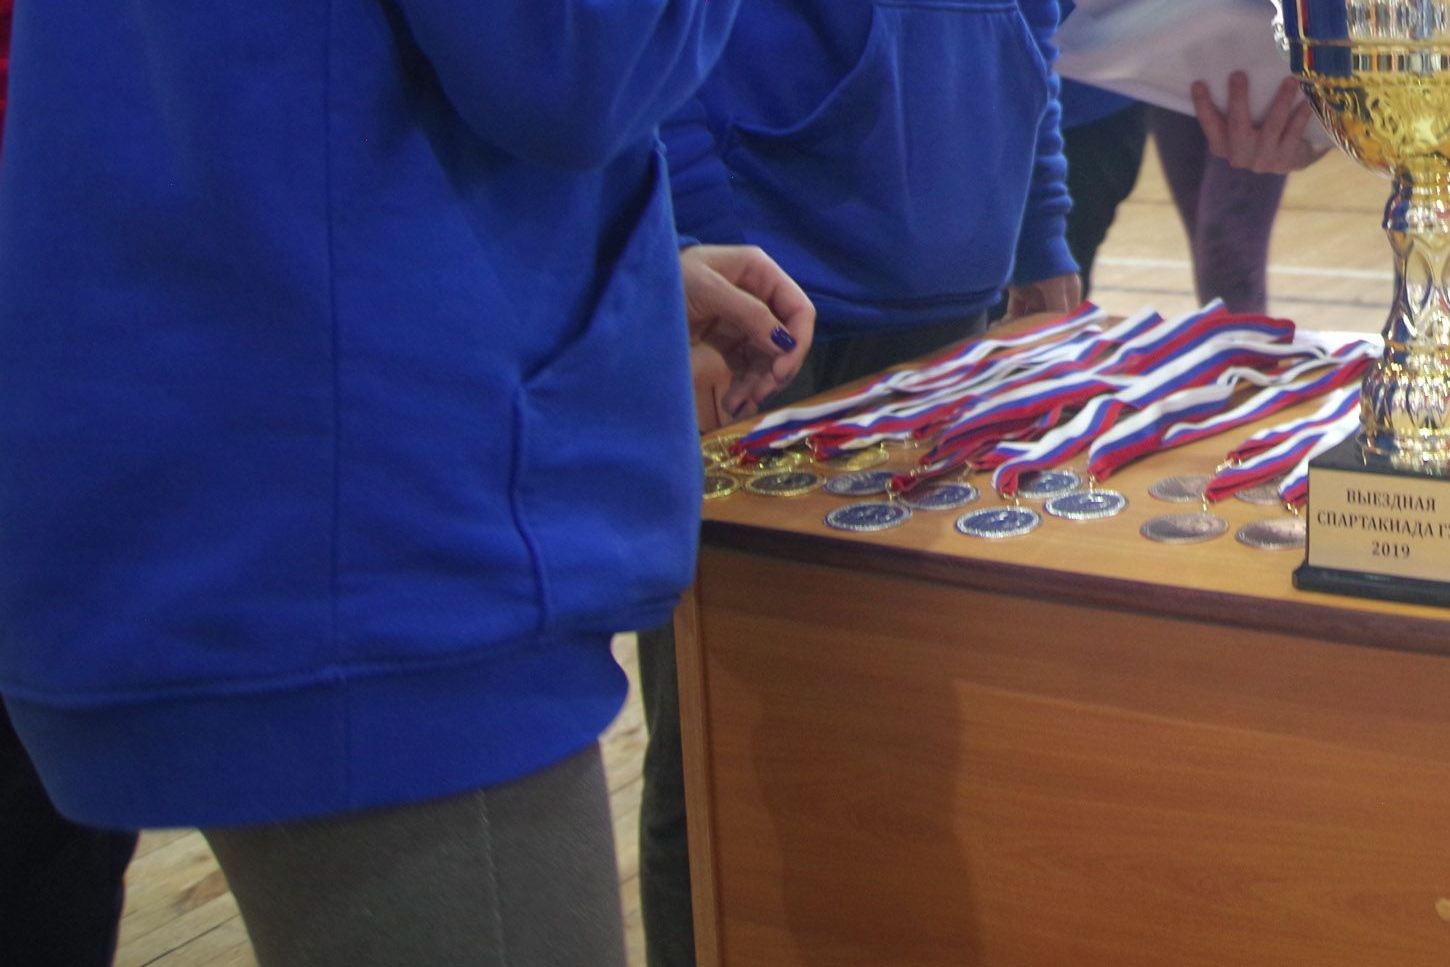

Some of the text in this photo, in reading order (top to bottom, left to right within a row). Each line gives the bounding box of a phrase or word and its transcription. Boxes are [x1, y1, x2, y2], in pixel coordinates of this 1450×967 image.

[1346, 489, 1436, 512] ВЫЕЗДНАЯ
[1317, 510, 1434, 539] СПАРТАКИАДА
[1371, 540, 1411, 560] 2019
